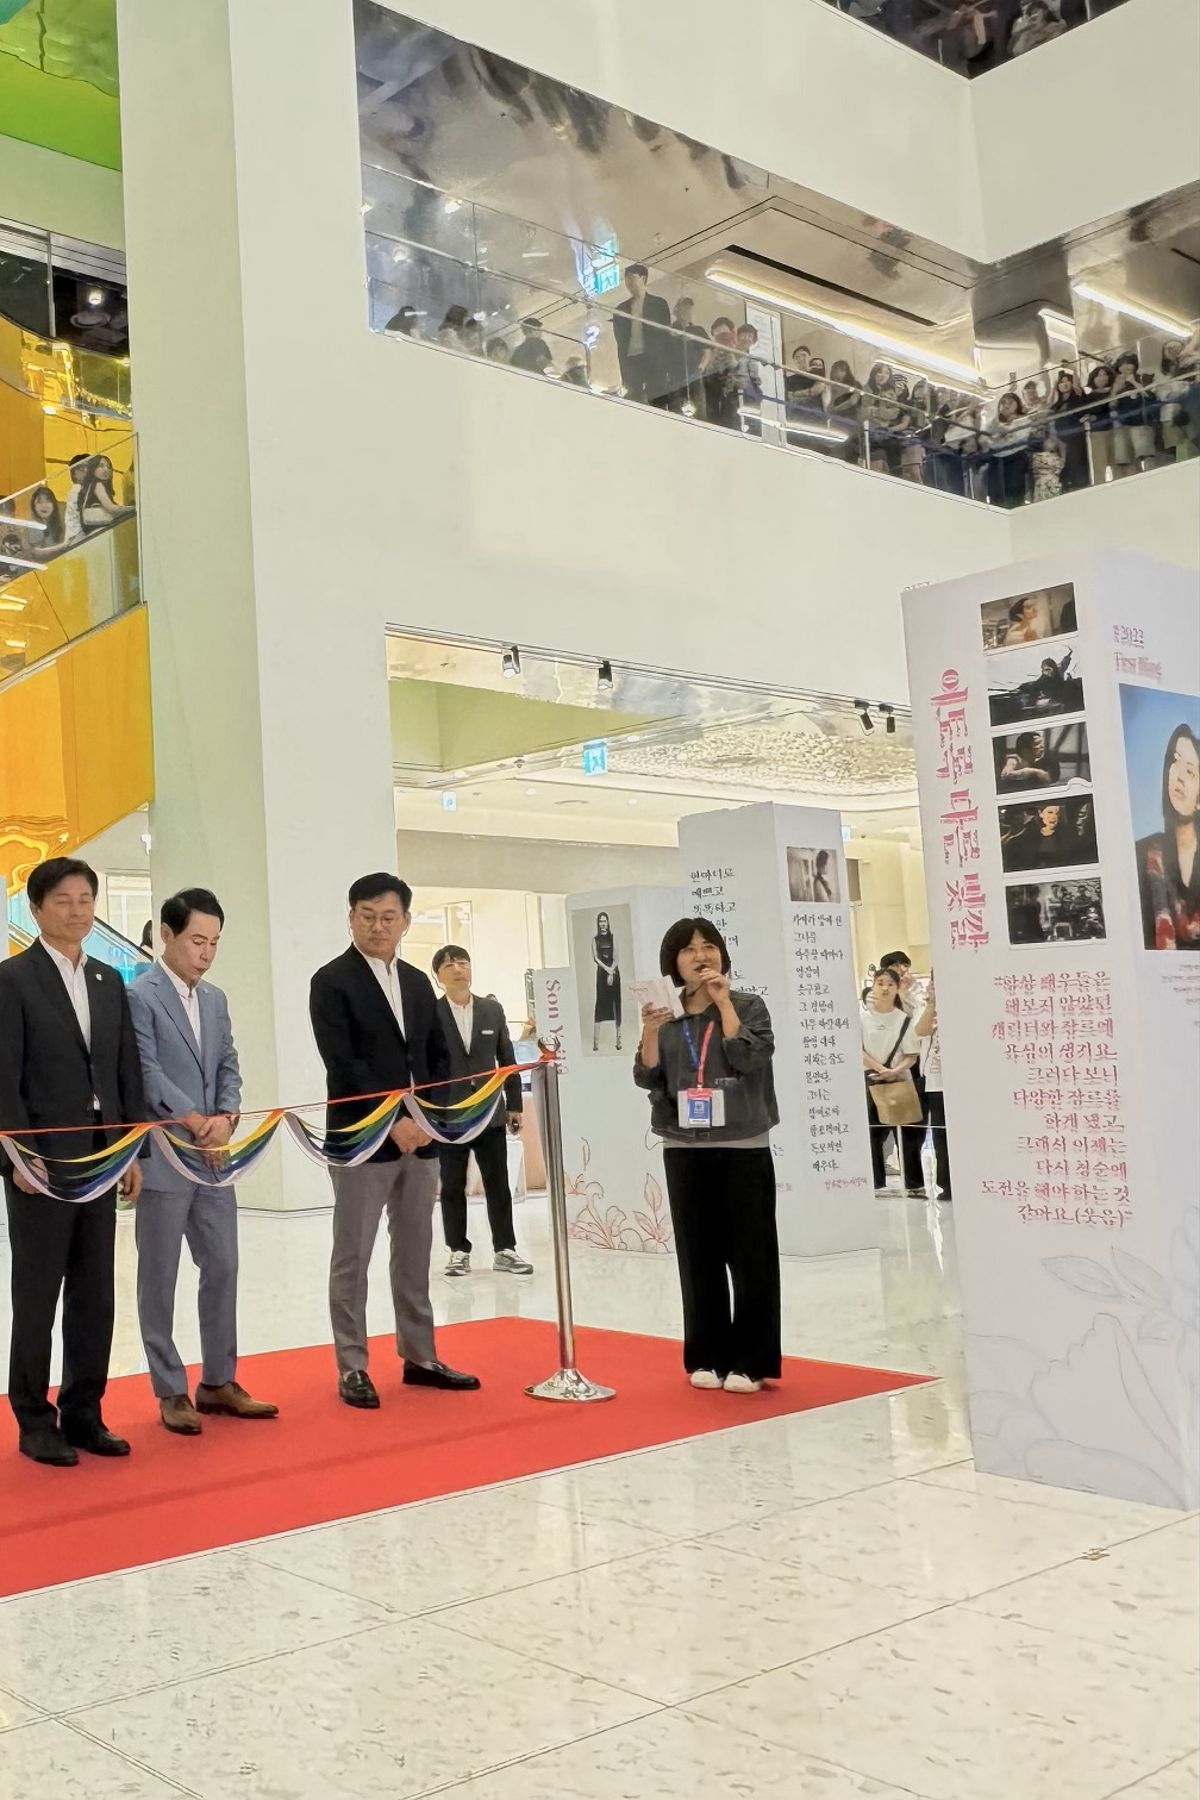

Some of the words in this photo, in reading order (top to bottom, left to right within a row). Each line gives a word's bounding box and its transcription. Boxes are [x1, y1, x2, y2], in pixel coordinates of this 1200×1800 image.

[930, 667, 975, 784] 이토록
[938, 787, 980, 868] 다른
[1041, 970, 1111, 993] 배우들은
[546, 979, 561, 1020] Son
[1060, 994, 1113, 1017] 않았던
[992, 1021, 1057, 1041] 캐릭터와
[1062, 1019, 1114, 1041] 장르에
[1027, 1066, 1080, 1086] 그러다
[1083, 1065, 1119, 1086] 보니
[1013, 1089, 1064, 1110] 다양한
[1067, 1089, 1121, 1111] 장르를
[1043, 1112, 1078, 1133] 하게
[1017, 1136, 1067, 1155] 그래서
[1072, 1136, 1128, 1156] 이제는
[1036, 1159, 1069, 1178] 다시
[981, 1179, 1031, 1198] 도전을
[1034, 1181, 1068, 1202] 해야
[1073, 1183, 1109, 1205] 하는
[1114, 1185, 1131, 1204] 것
